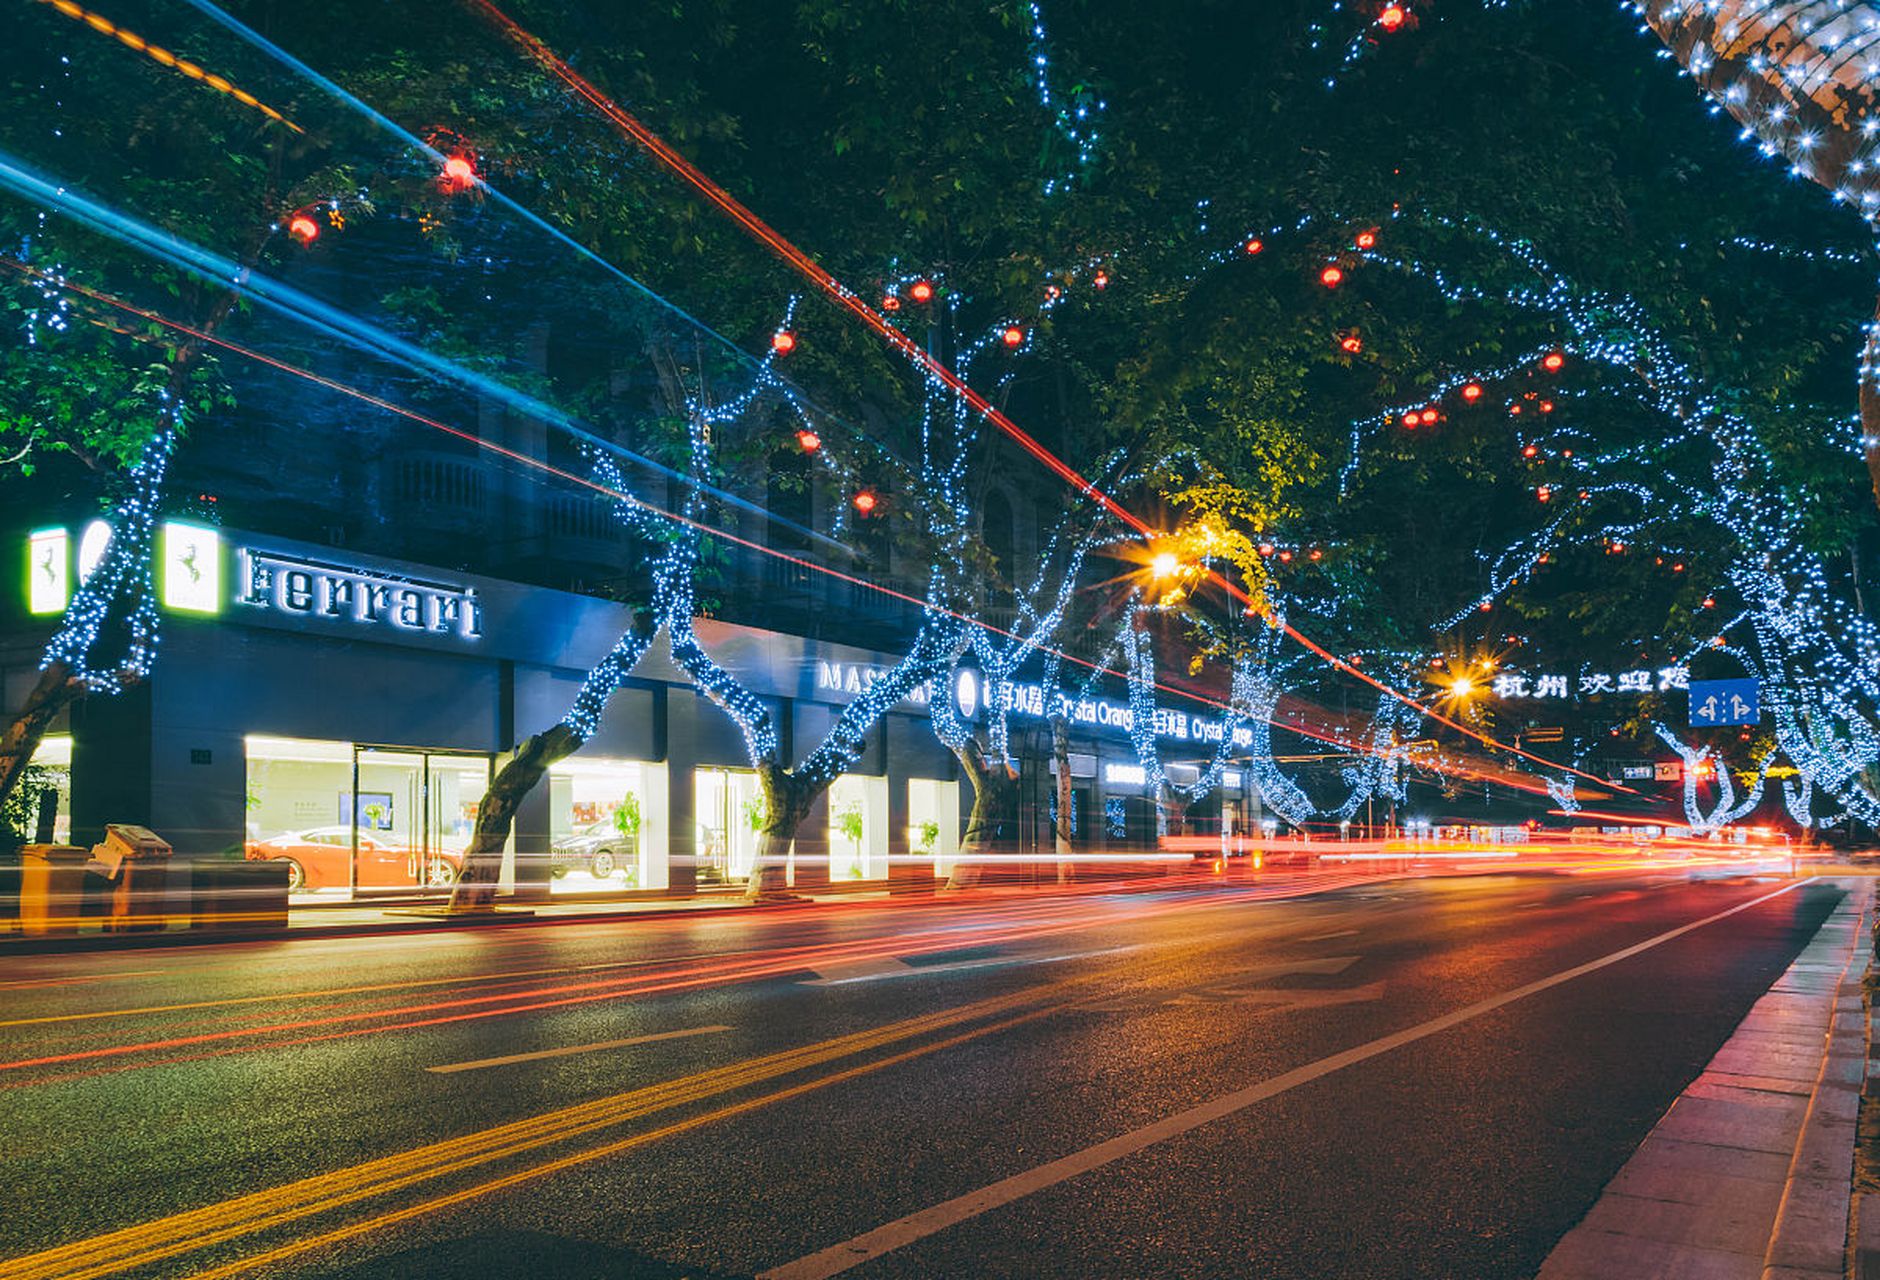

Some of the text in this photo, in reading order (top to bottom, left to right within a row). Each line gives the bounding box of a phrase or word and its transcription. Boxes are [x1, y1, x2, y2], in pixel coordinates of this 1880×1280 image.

[237, 547, 482, 638] Ferrari
[1098, 701, 1135, 732] Orang
[1192, 718, 1223, 743] Crystal
